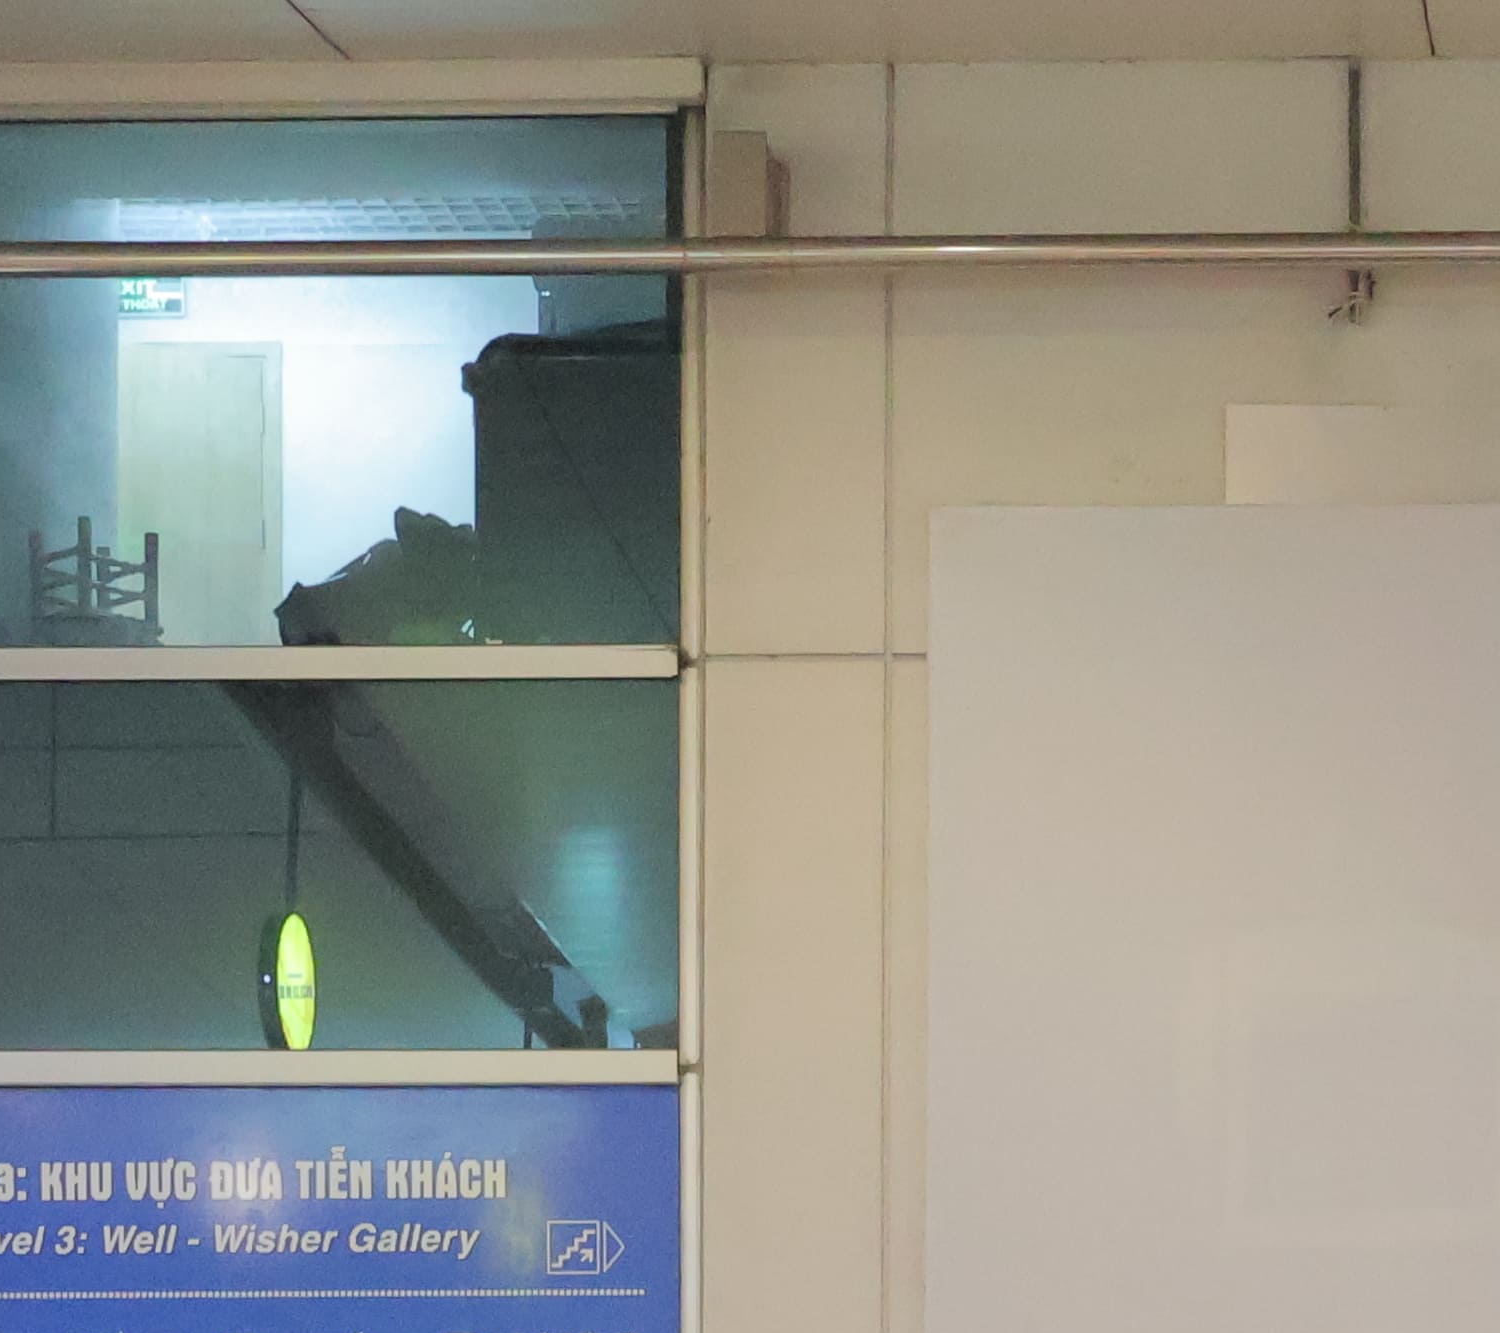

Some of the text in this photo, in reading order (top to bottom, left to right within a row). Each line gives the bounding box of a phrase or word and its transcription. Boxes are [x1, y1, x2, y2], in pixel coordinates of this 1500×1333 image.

[39, 1160, 113, 1202] KHU
[125, 1156, 197, 1209] VỰC
[208, 1156, 283, 1201] ĐƯA
[295, 1145, 373, 1200] TIỄN
[385, 1150, 508, 1200] KHÁCH
[53, 1225, 88, 1255] 3:
[102, 1223, 178, 1255] Well
[187, 1238, 200, 1246] -
[212, 1222, 339, 1255] Wisher
[348, 1221, 482, 1261] Gallery
